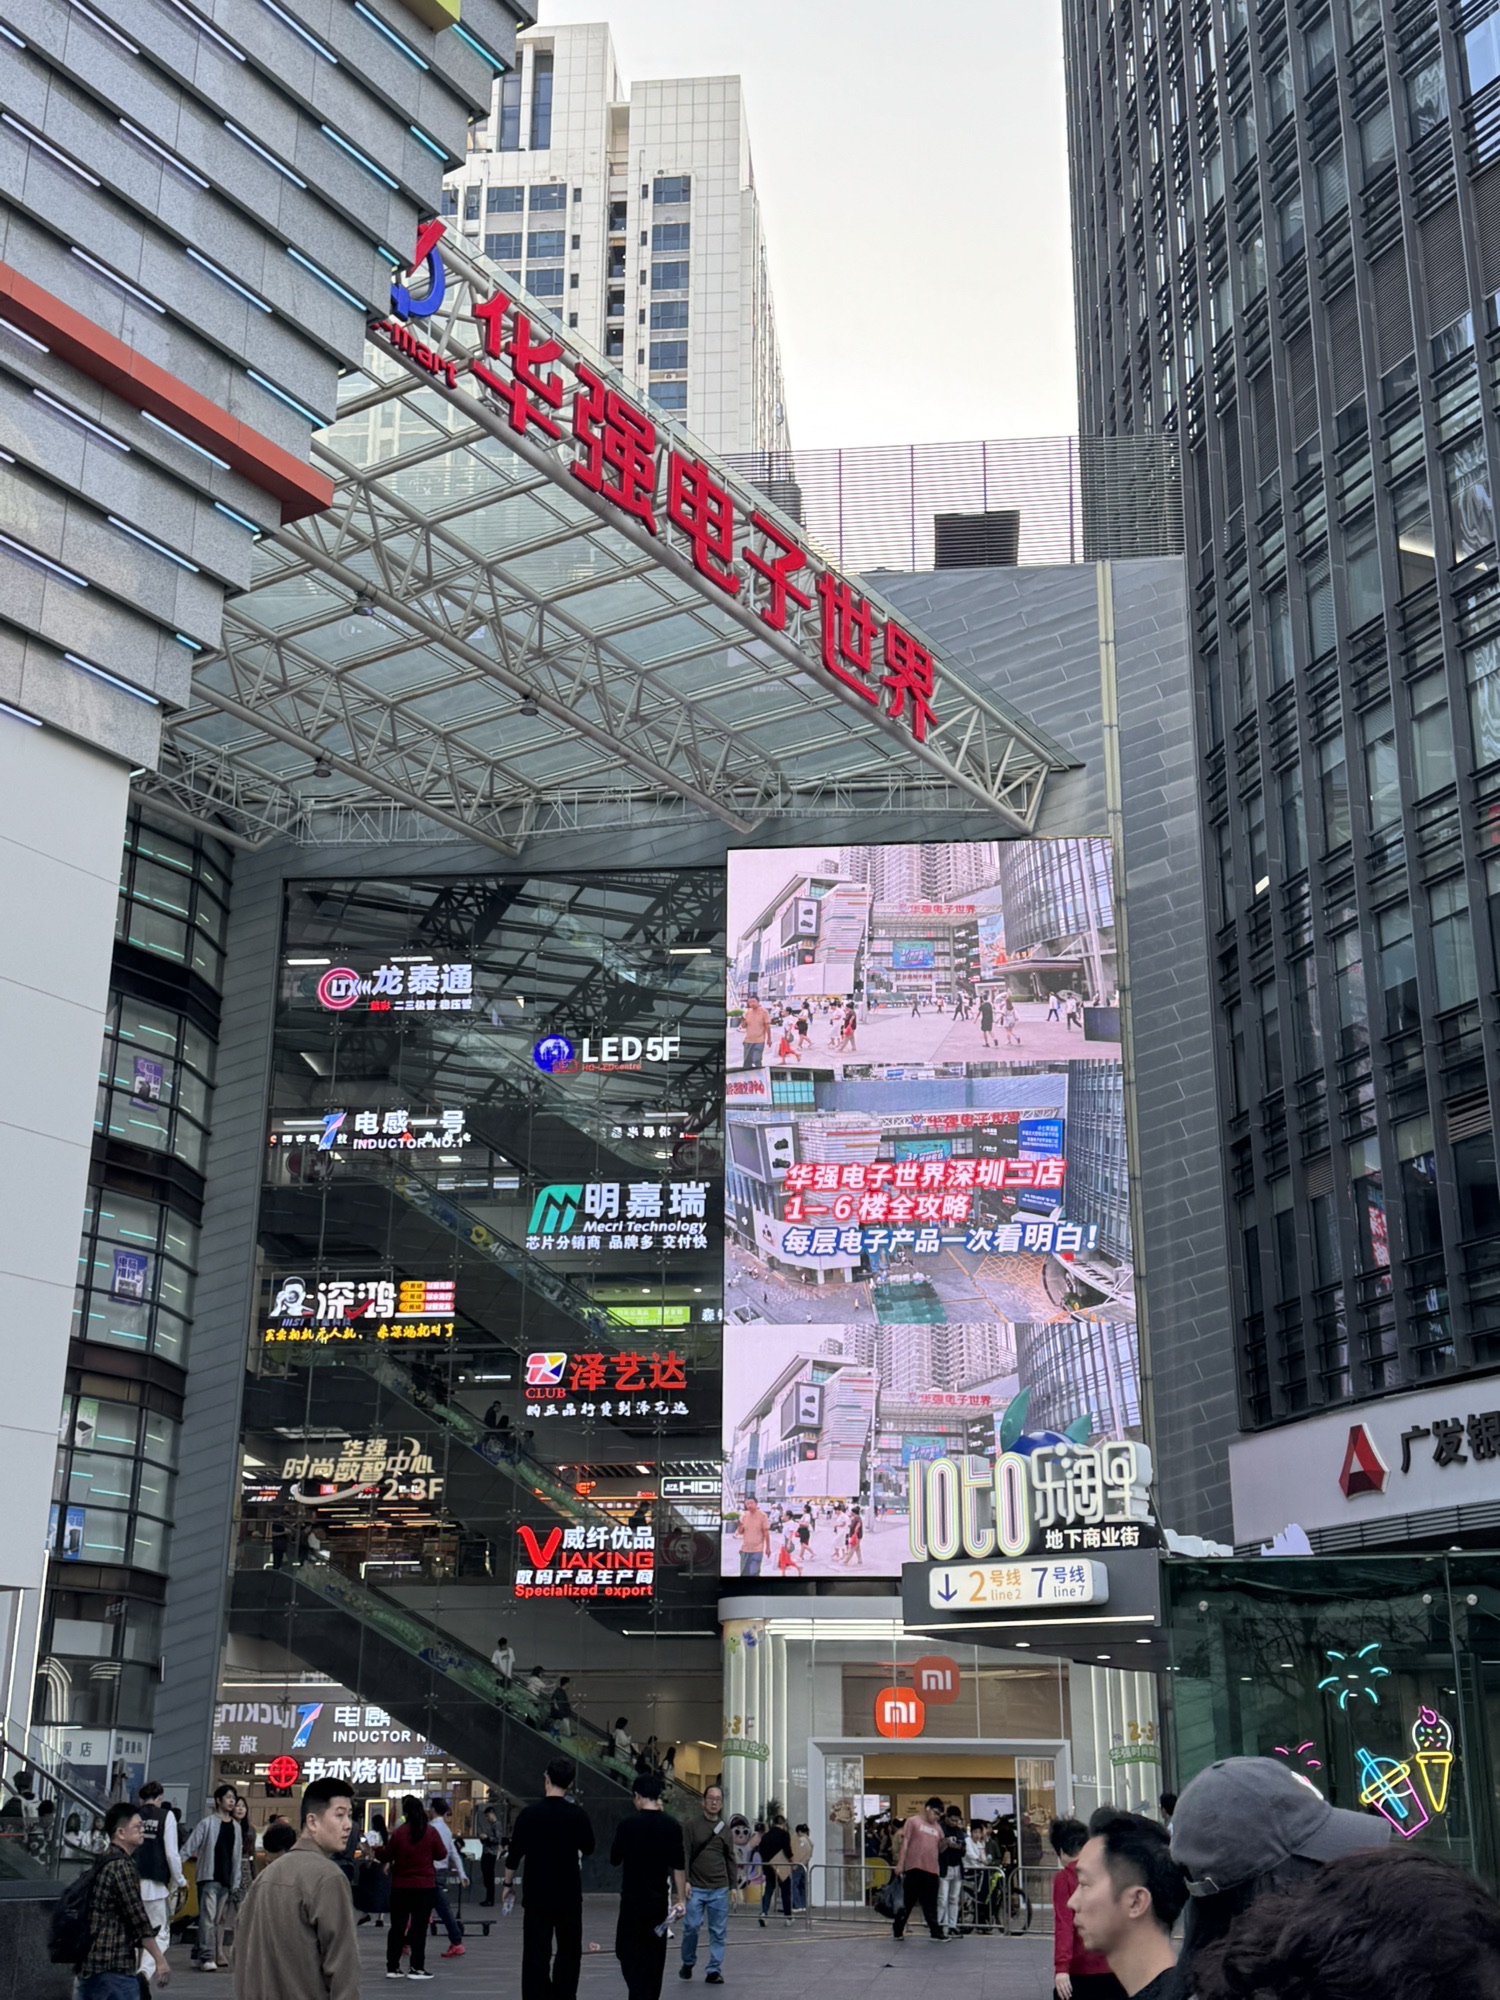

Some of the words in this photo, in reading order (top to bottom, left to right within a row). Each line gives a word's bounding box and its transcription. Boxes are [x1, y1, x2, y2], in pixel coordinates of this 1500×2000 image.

[470, 290, 938, 743] 华强电子世界
[371, 963, 473, 996] 龙泰通
[582, 1037, 642, 1062] LED
[646, 1036, 680, 1061] 5F
[355, 1110, 465, 1135] 电感一号
[353, 1138, 426, 1150] INDUCTOR
[432, 1137, 463, 1148] NO.1
[786, 1159, 1065, 1190] 华强电子世界深圳二店
[585, 1181, 707, 1219] 明嘉瑞
[526, 1235, 601, 1250] 芯片分销商
[609, 1235, 654, 1250] 品牌多
[663, 1234, 707, 1250] 交付快
[627, 1221, 706, 1237] Technology
[316, 1280, 397, 1320] 深鸿
[569, 1351, 687, 1391] 泽艺达
[525, 1387, 567, 1399] CLUB
[337, 1438, 388, 1458] 华强
[1401, 1410, 1500, 1474] 广发银
[281, 1437, 436, 1483] 时尚数智中心
[1031, 1440, 1154, 1528] 乐淘里
[562, 1526, 655, 1550] 威纤优品
[1045, 1526, 1140, 1550] 地下商业街
[516, 1569, 654, 1584] 数码产品生产商
[969, 1570, 987, 1603] 2
[990, 1569, 1021, 1587] 号线
[1031, 1567, 1049, 1598] 7
[1052, 1565, 1086, 1584] 号线
[515, 1584, 598, 1598] Specialized
[604, 1584, 653, 1598] export
[333, 1731, 410, 1743] INDUCTOR
[302, 1757, 426, 1785] 书亦烧仙草
